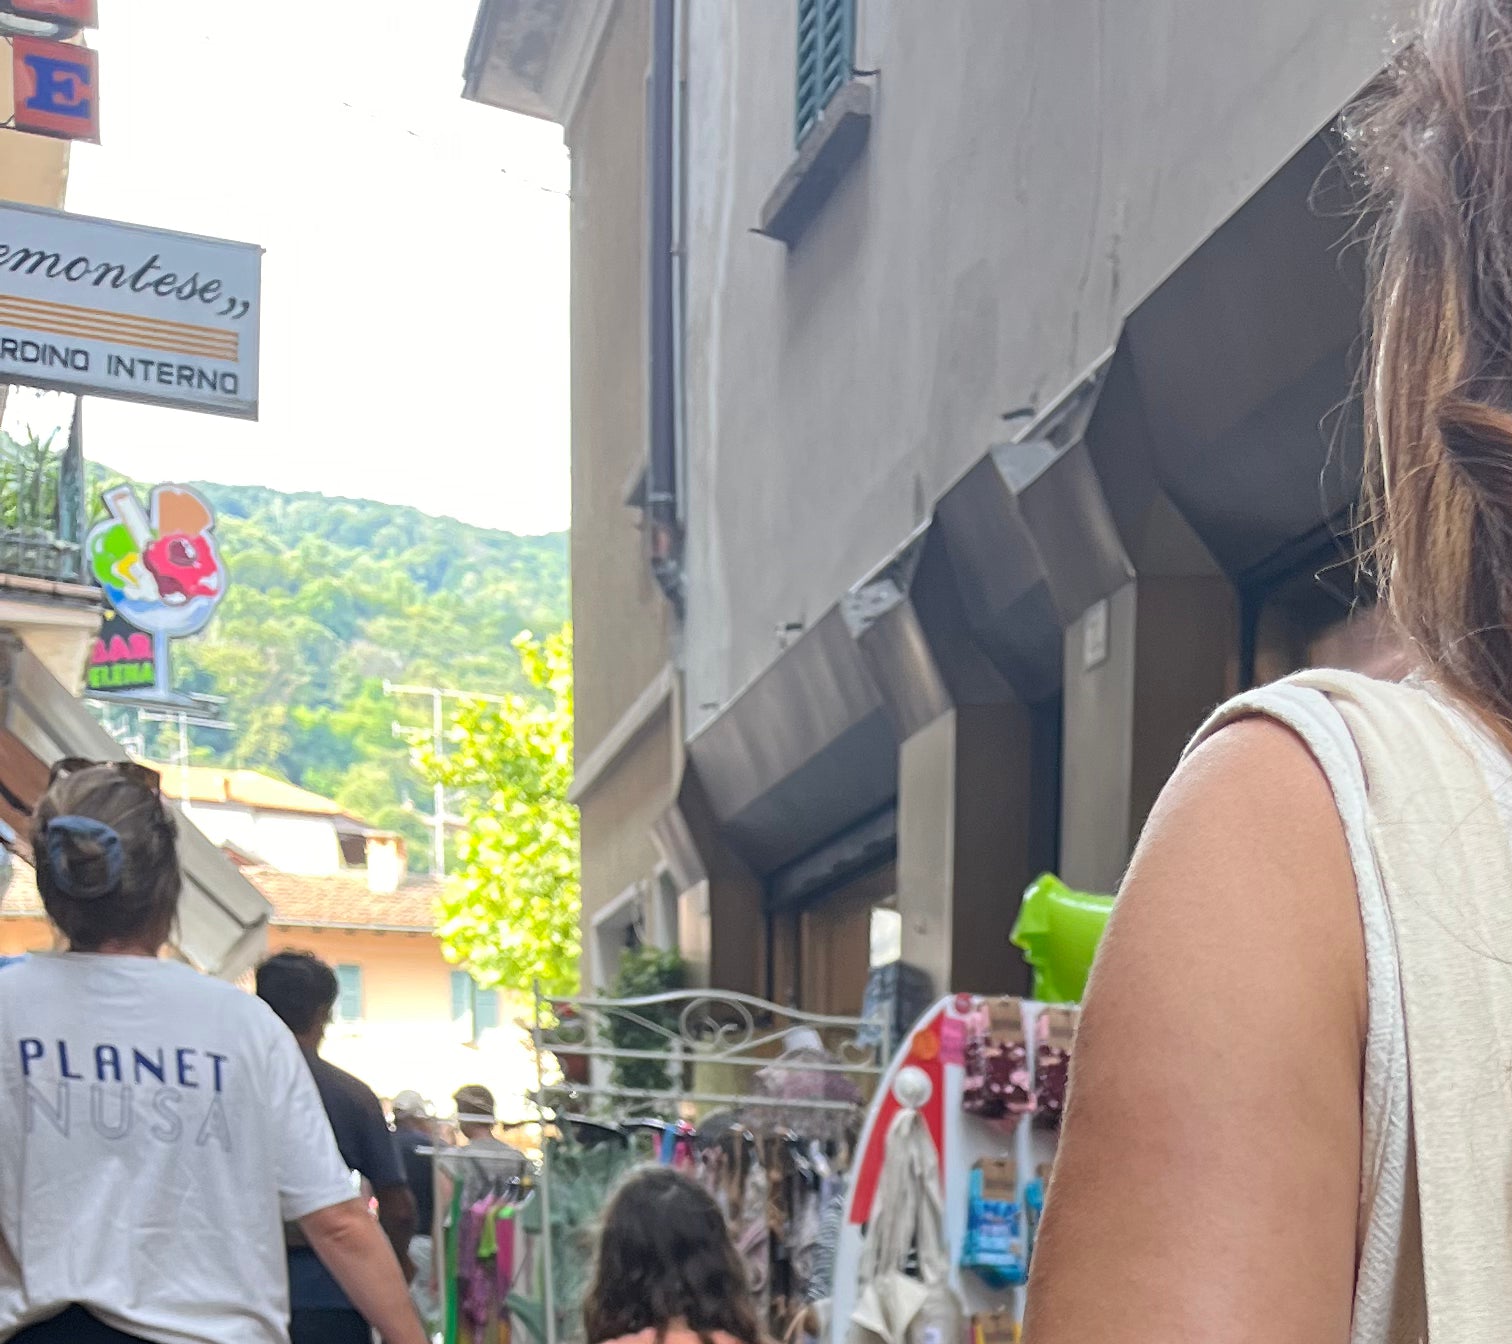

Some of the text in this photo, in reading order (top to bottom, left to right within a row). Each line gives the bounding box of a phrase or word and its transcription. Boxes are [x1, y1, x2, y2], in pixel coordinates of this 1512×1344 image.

[24, 53, 91, 119] E
[0, 337, 239, 395] RDINO INTERNO
[19, 1037, 227, 1092] PLANET
[9, 1080, 232, 1152] NUSA
